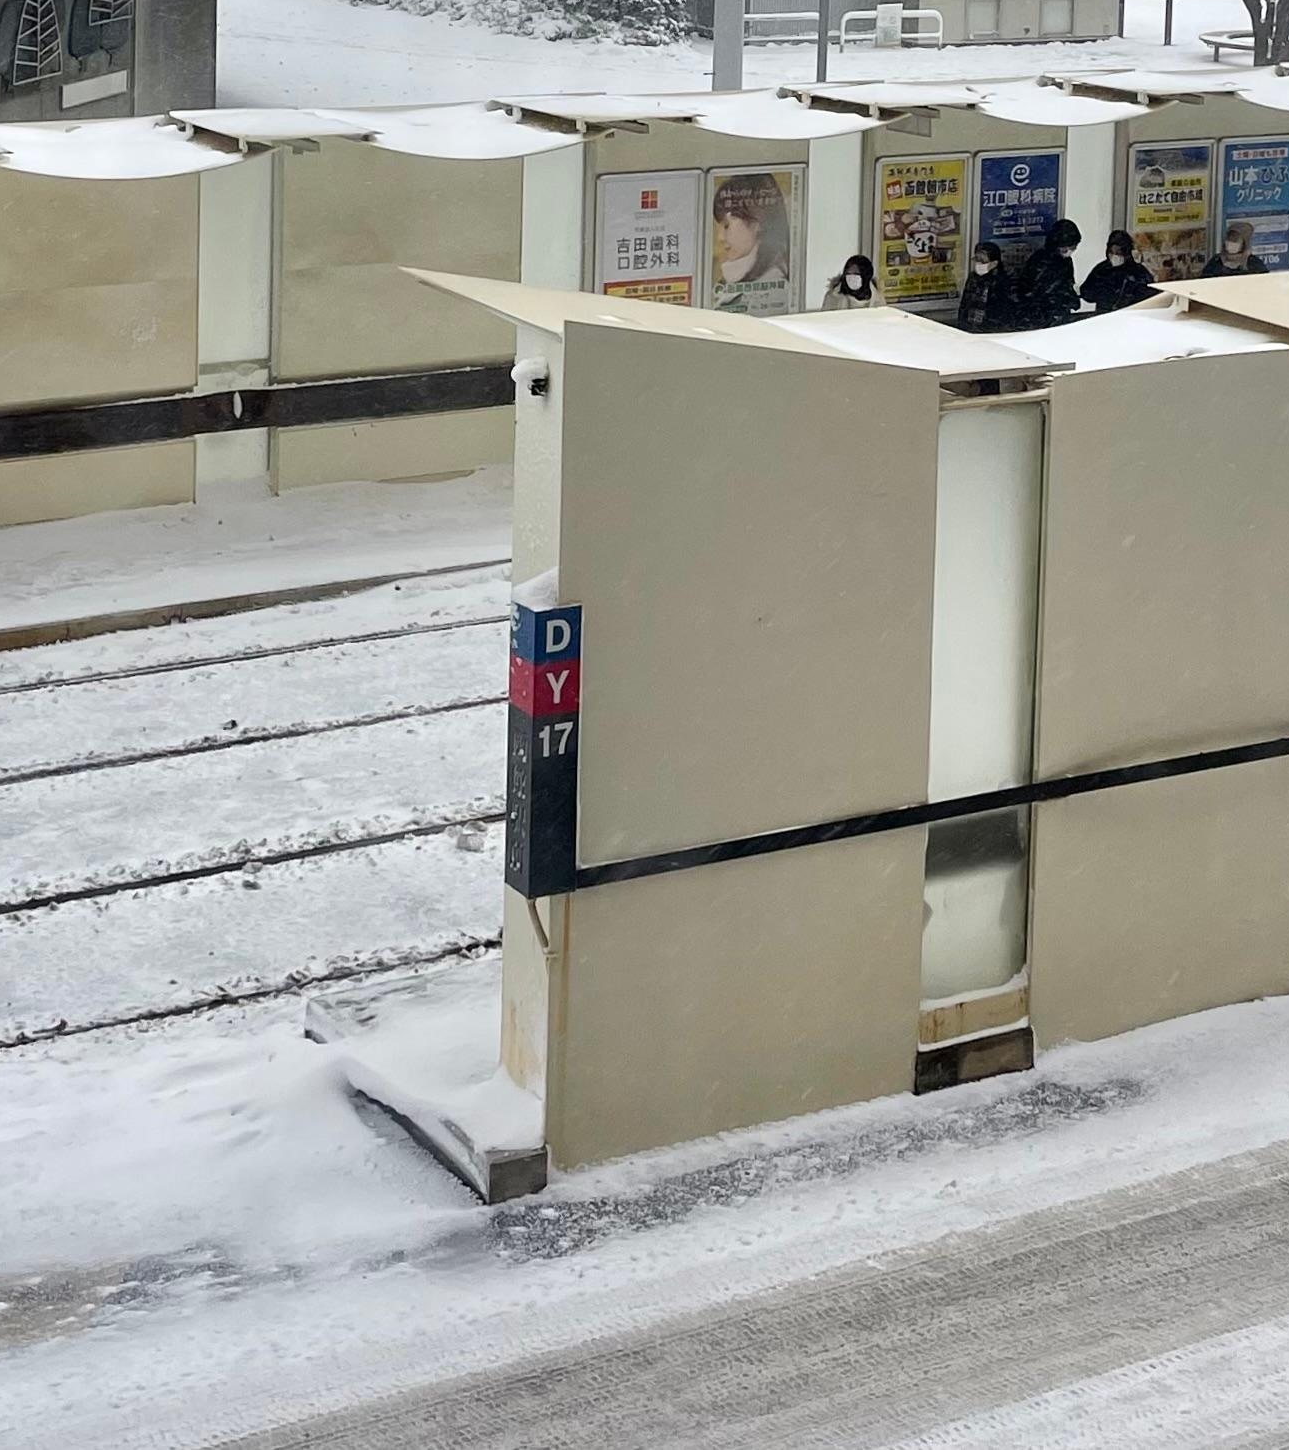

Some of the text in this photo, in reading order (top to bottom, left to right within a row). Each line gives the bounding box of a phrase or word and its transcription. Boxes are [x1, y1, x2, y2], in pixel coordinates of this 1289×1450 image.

[616, 234, 680, 254] 吉田歯科
[617, 251, 680, 270] 口腔外科
[546, 619, 571, 653] D
[546, 670, 569, 704] Y
[538, 722, 573, 757] 17
